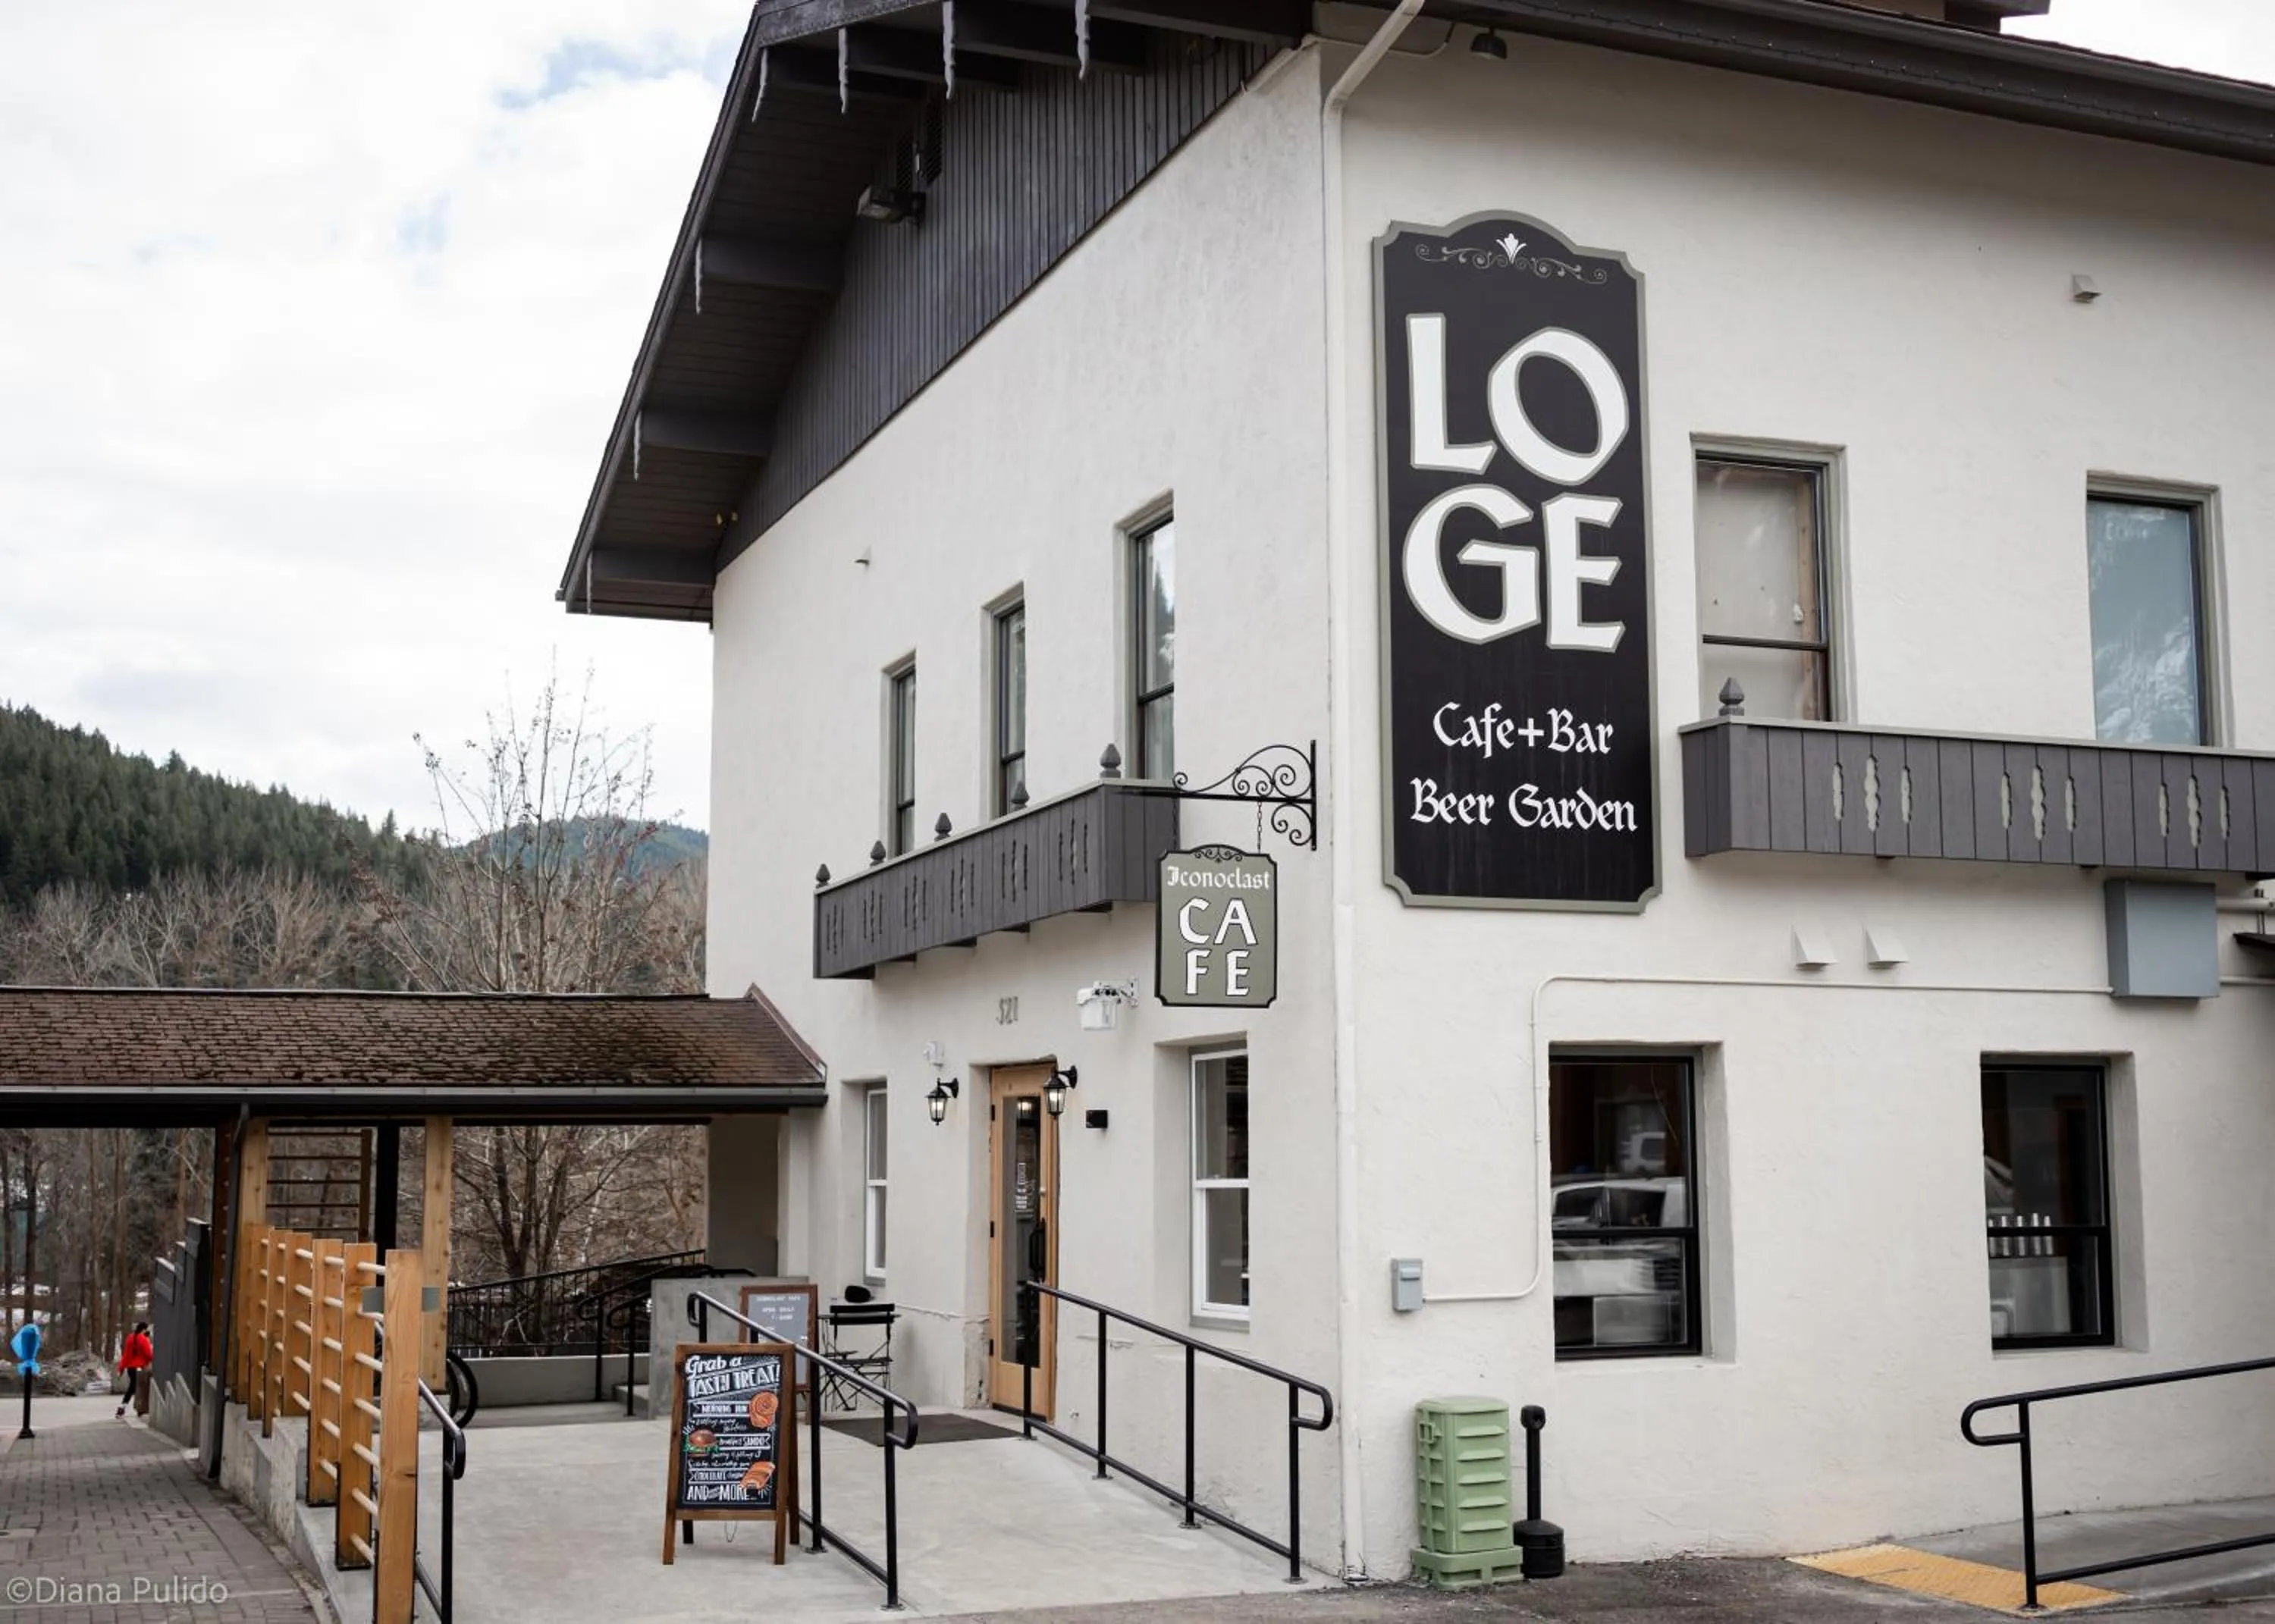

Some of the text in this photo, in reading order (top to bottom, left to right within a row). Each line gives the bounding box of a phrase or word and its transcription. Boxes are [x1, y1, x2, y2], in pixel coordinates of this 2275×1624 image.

[1433, 701, 1614, 758] Cafe+Bar
[1410, 777, 1638, 831] Beer Garden
[1167, 866, 1270, 890] Iconoclast
[686, 1355, 742, 1380] Grab a
[688, 1364, 780, 1398] TASTY TREAT!
[687, 1484, 708, 1500] AND
